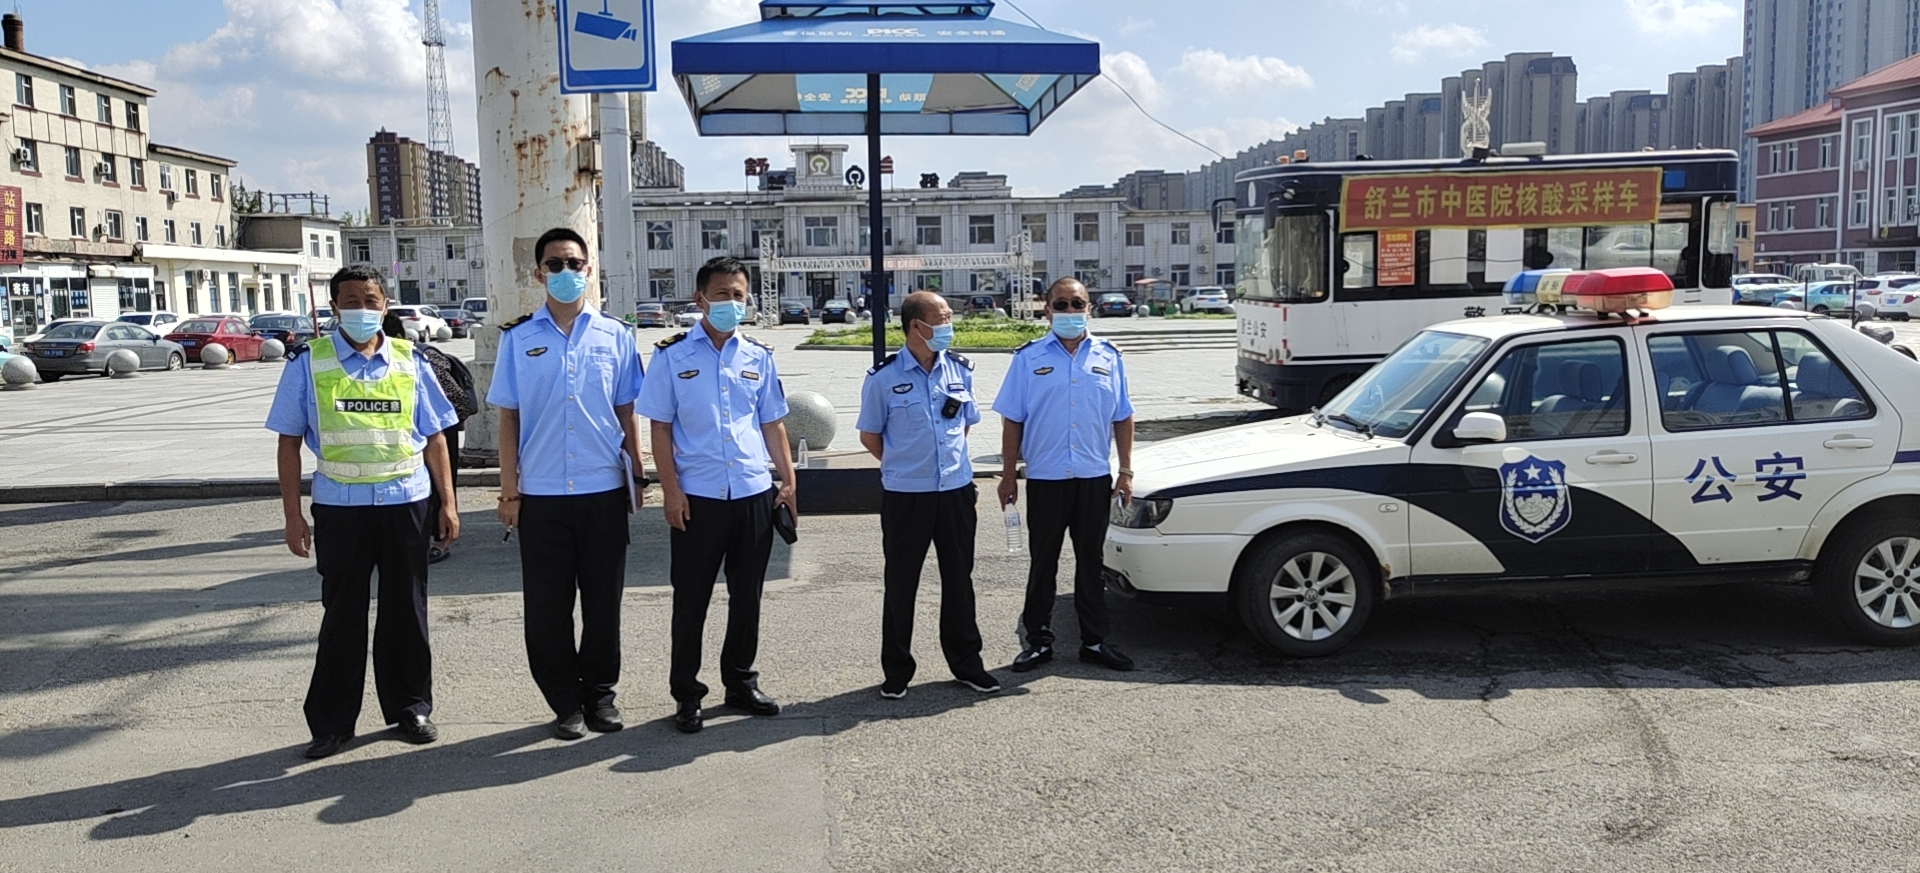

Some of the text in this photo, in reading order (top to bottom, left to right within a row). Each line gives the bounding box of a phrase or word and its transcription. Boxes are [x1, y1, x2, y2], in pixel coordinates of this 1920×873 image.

[3, 190, 16, 246] 站前路
[1364, 180, 1640, 220] 舒兰市中医院核酸采样车
[12, 282, 30, 295] 寄存
[347, 401, 389, 411] POLICE
[1684, 451, 1807, 504] 公安
